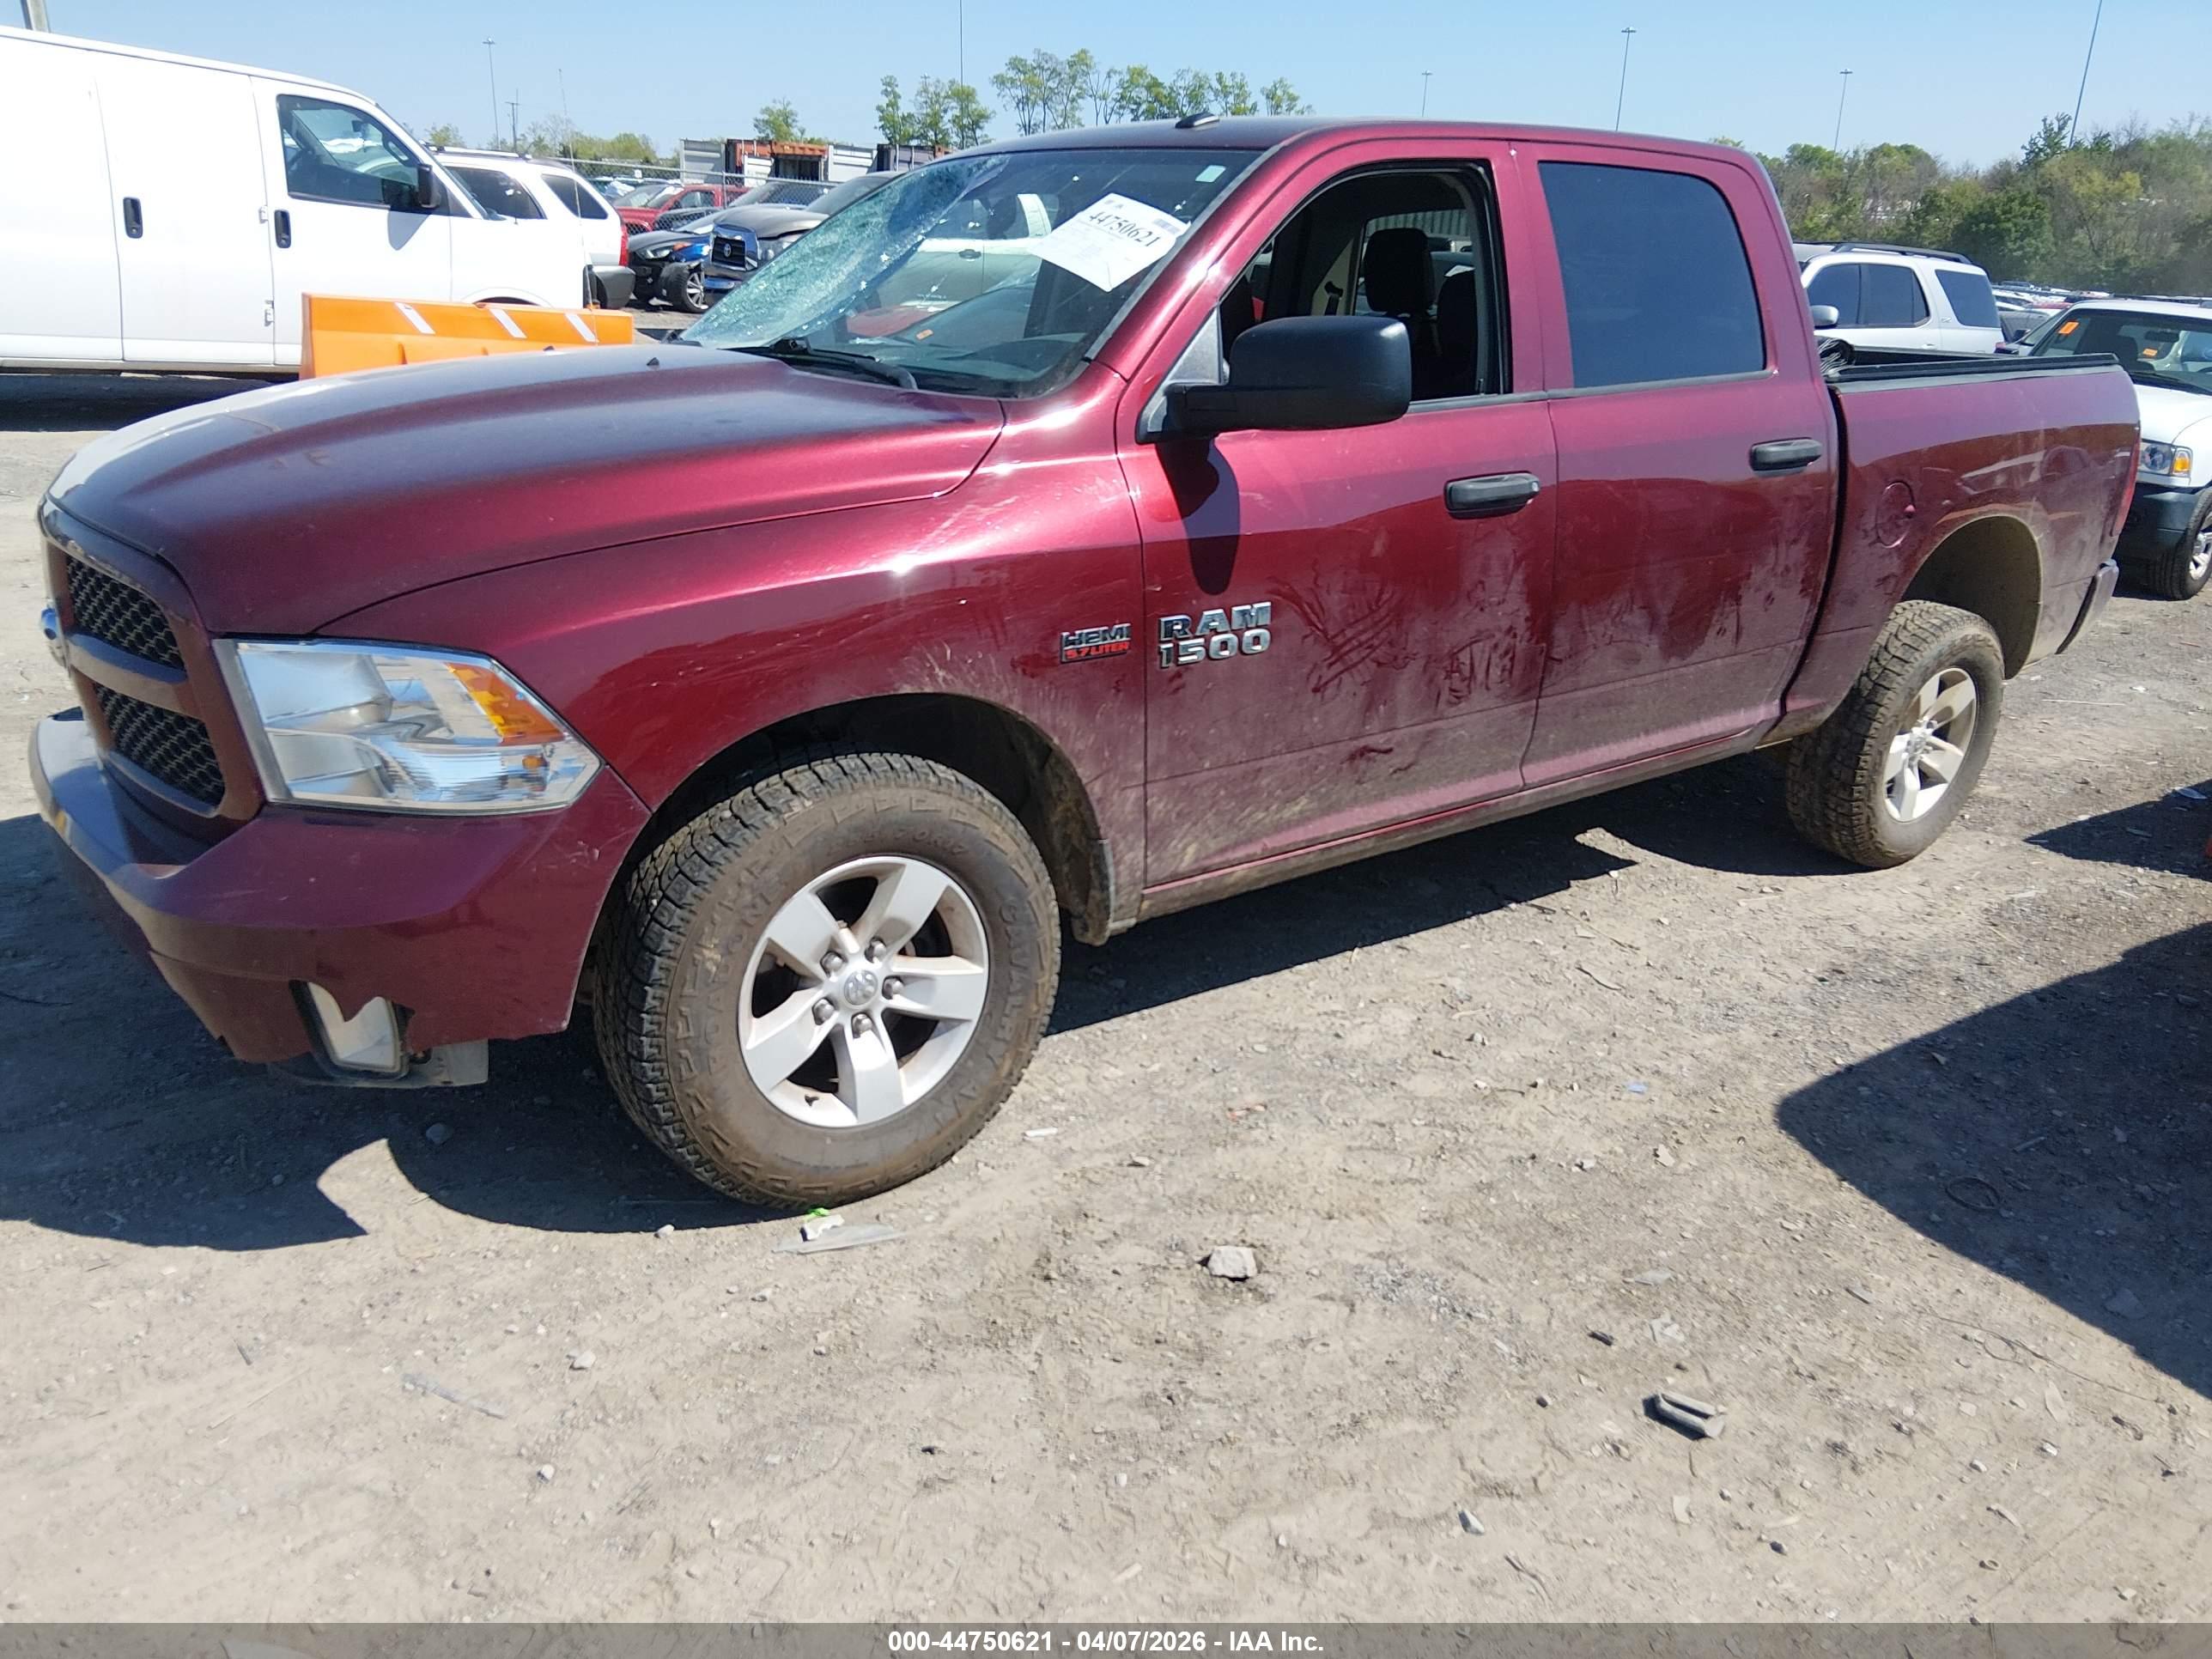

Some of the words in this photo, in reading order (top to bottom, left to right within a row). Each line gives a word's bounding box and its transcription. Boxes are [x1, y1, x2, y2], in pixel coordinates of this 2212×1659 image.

[1089, 211, 1160, 246] 44750621
[1061, 623, 1131, 650] HEMI
[1159, 602, 1272, 640] RAM
[1159, 629, 1272, 668] 1500
